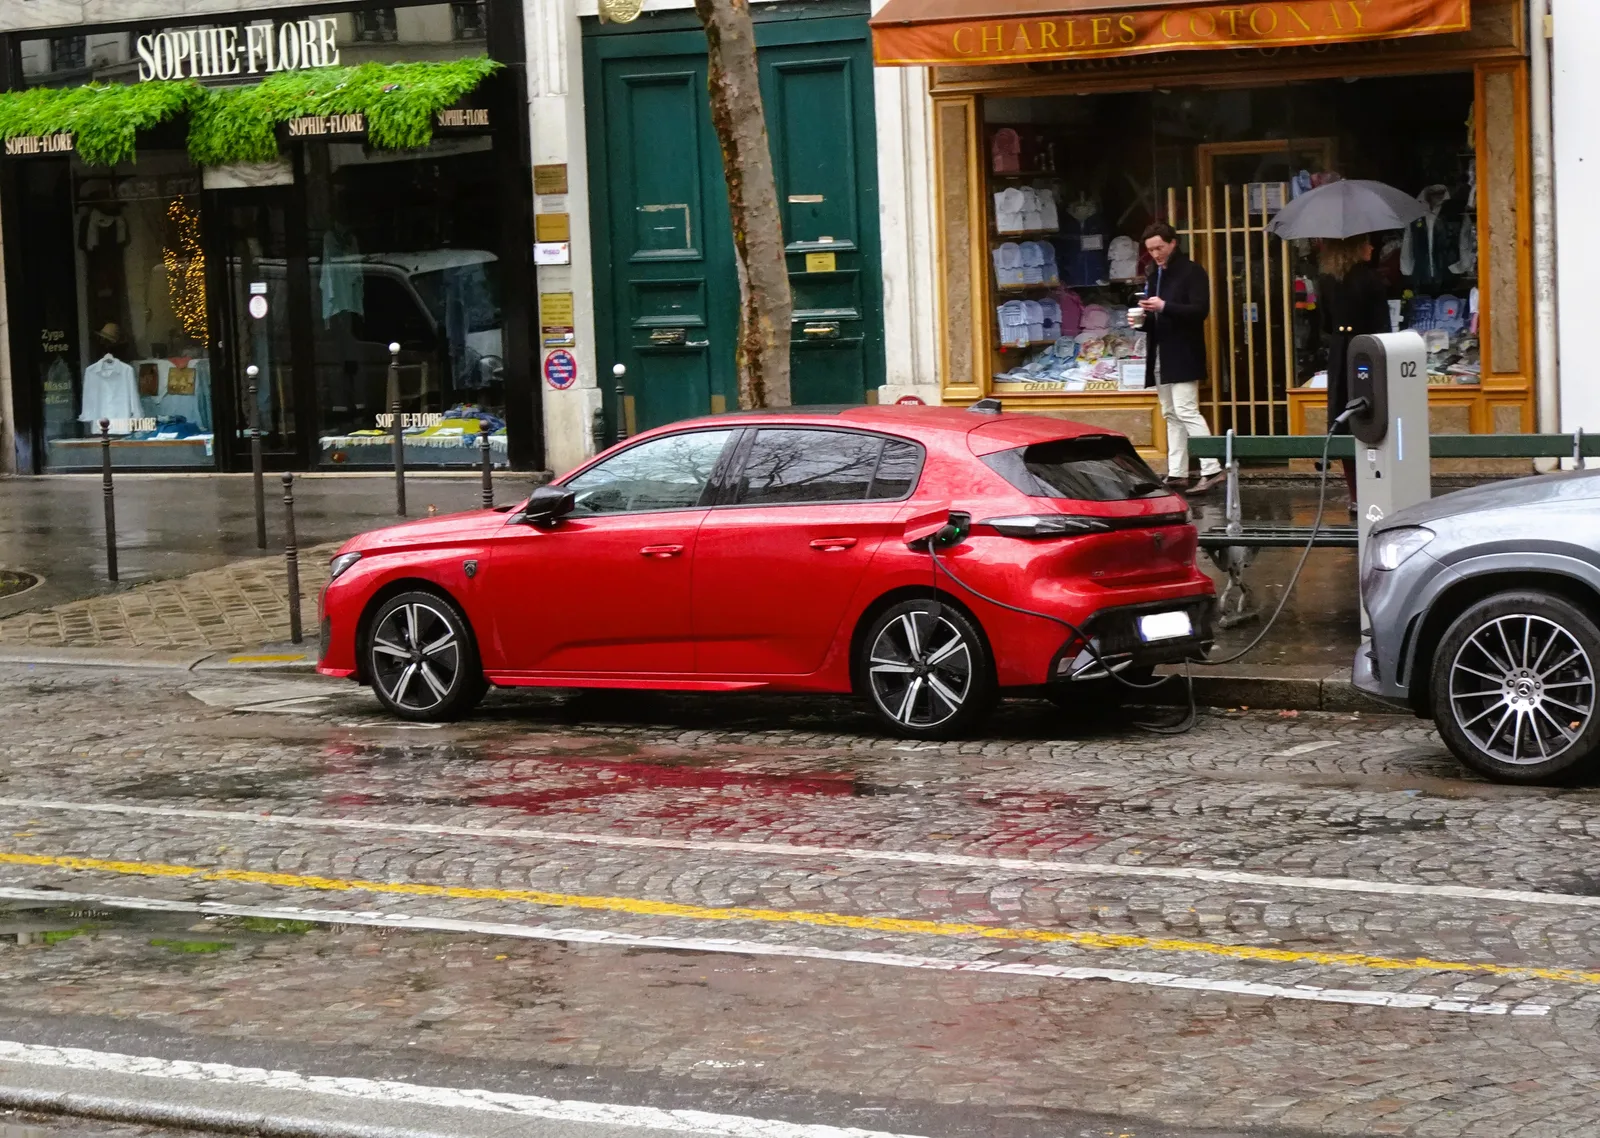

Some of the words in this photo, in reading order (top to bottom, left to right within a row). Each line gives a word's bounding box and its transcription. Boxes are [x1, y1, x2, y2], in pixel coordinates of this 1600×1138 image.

[953, 15, 1137, 54] CHARLES
[1160, 0, 1370, 39] COTONAY
[136, 17, 340, 82] SOPHIE-FLORE
[288, 113, 364, 136] SOPHIE-FLORE
[436, 108, 490, 126] SOPHIE-FLORE
[5, 132, 73, 155] SOPHIE-FLORE
[41, 329, 65, 341] Zyga
[42, 342, 69, 353] Yerse
[1400, 361, 1417, 378] 02
[1024, 381, 1066, 391] CHARLE
[375, 413, 442, 427] SOPIE-FLORE
